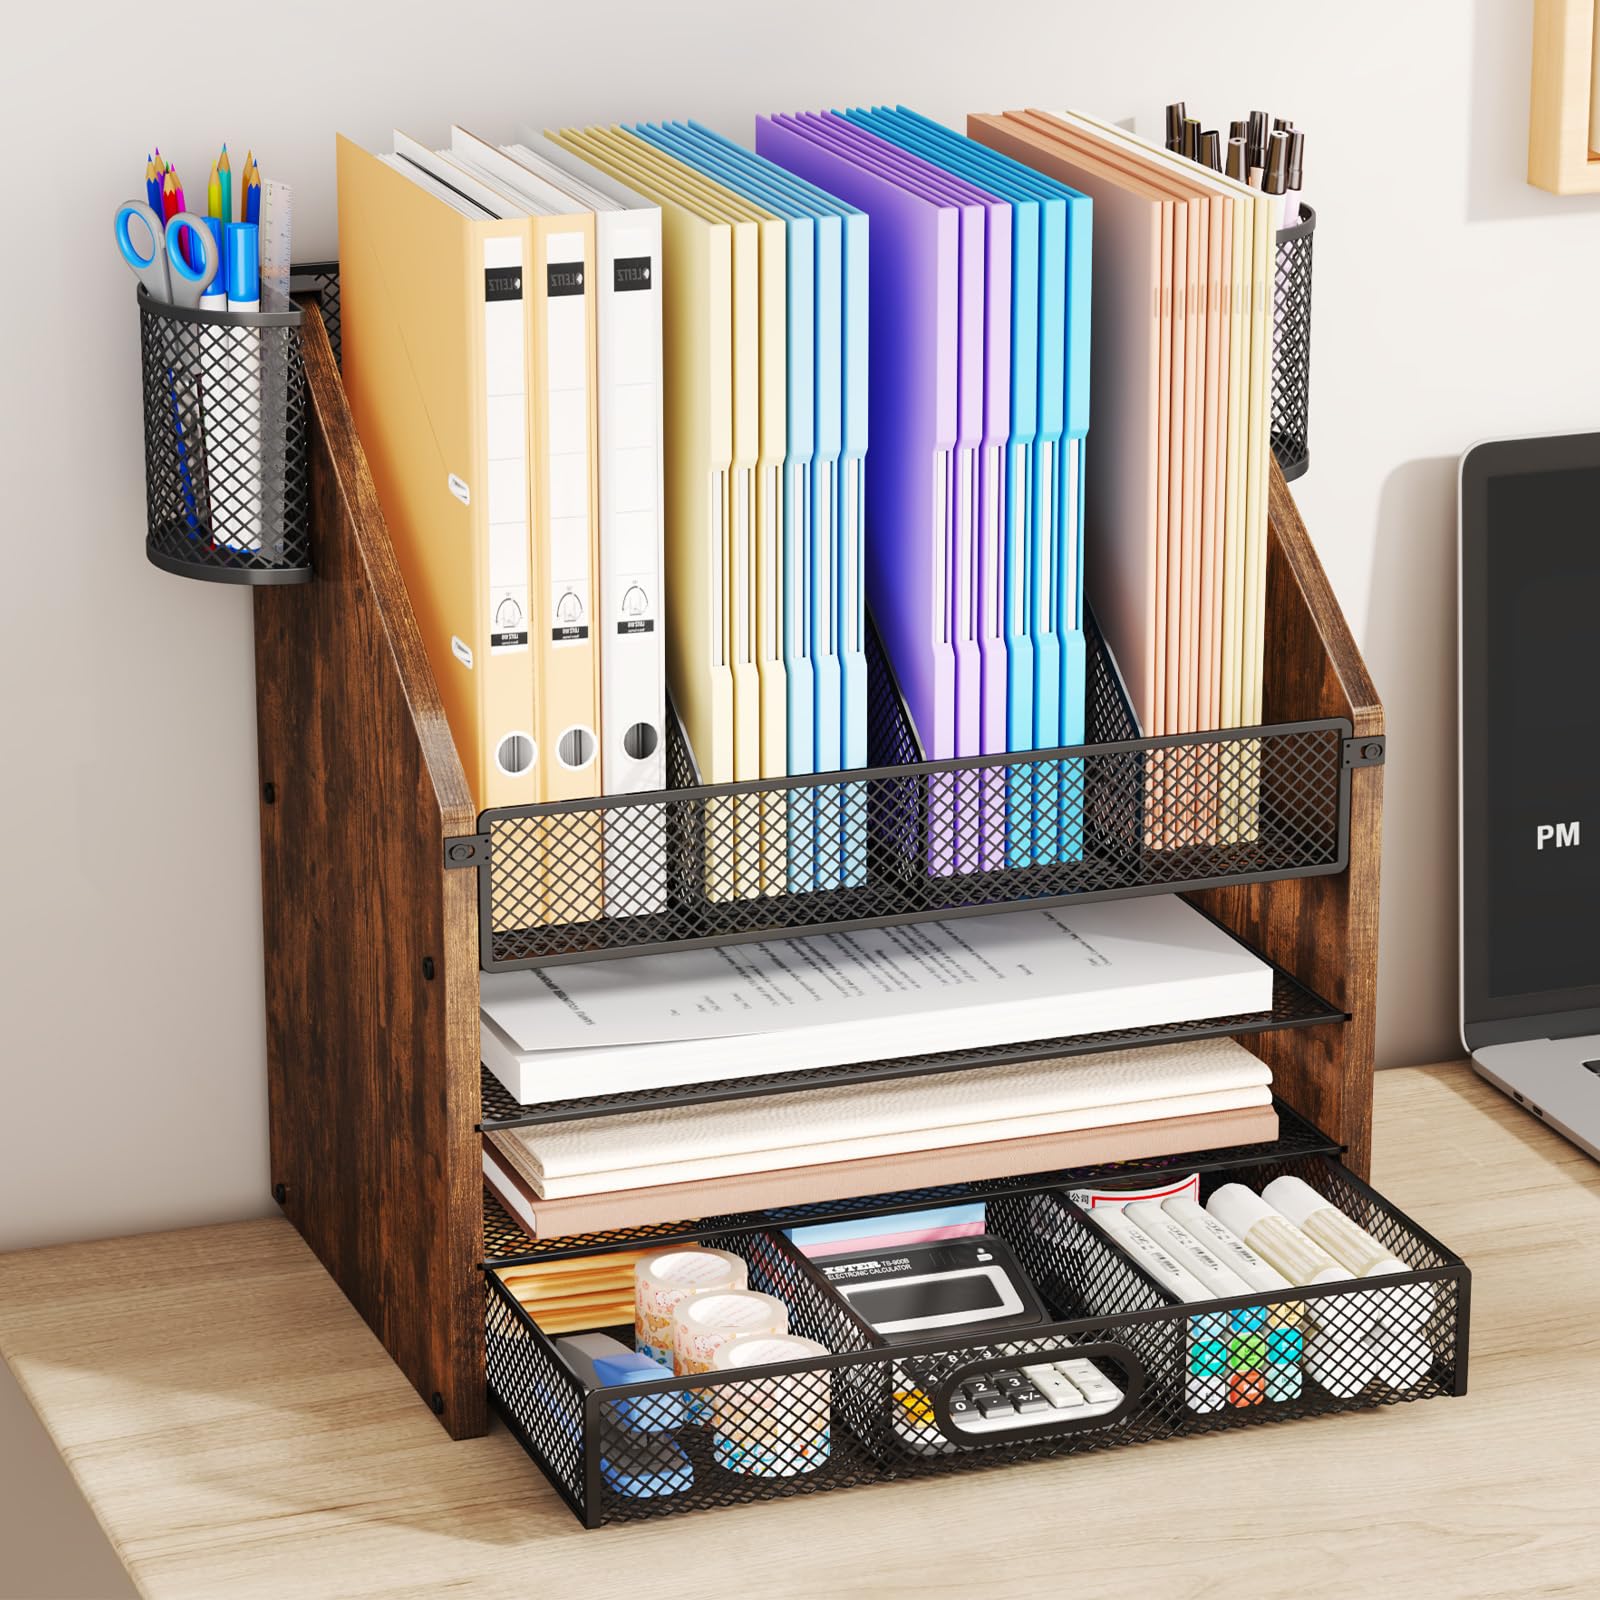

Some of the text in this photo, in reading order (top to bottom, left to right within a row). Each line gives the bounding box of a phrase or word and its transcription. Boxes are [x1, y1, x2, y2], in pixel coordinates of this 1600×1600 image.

[1537, 821, 1580, 850] PM
[827, 1263, 913, 1281] ELECTRONIC CALCULATOR
[975, 1378, 1021, 1391] 2 3
[955, 1402, 967, 1411] 0
